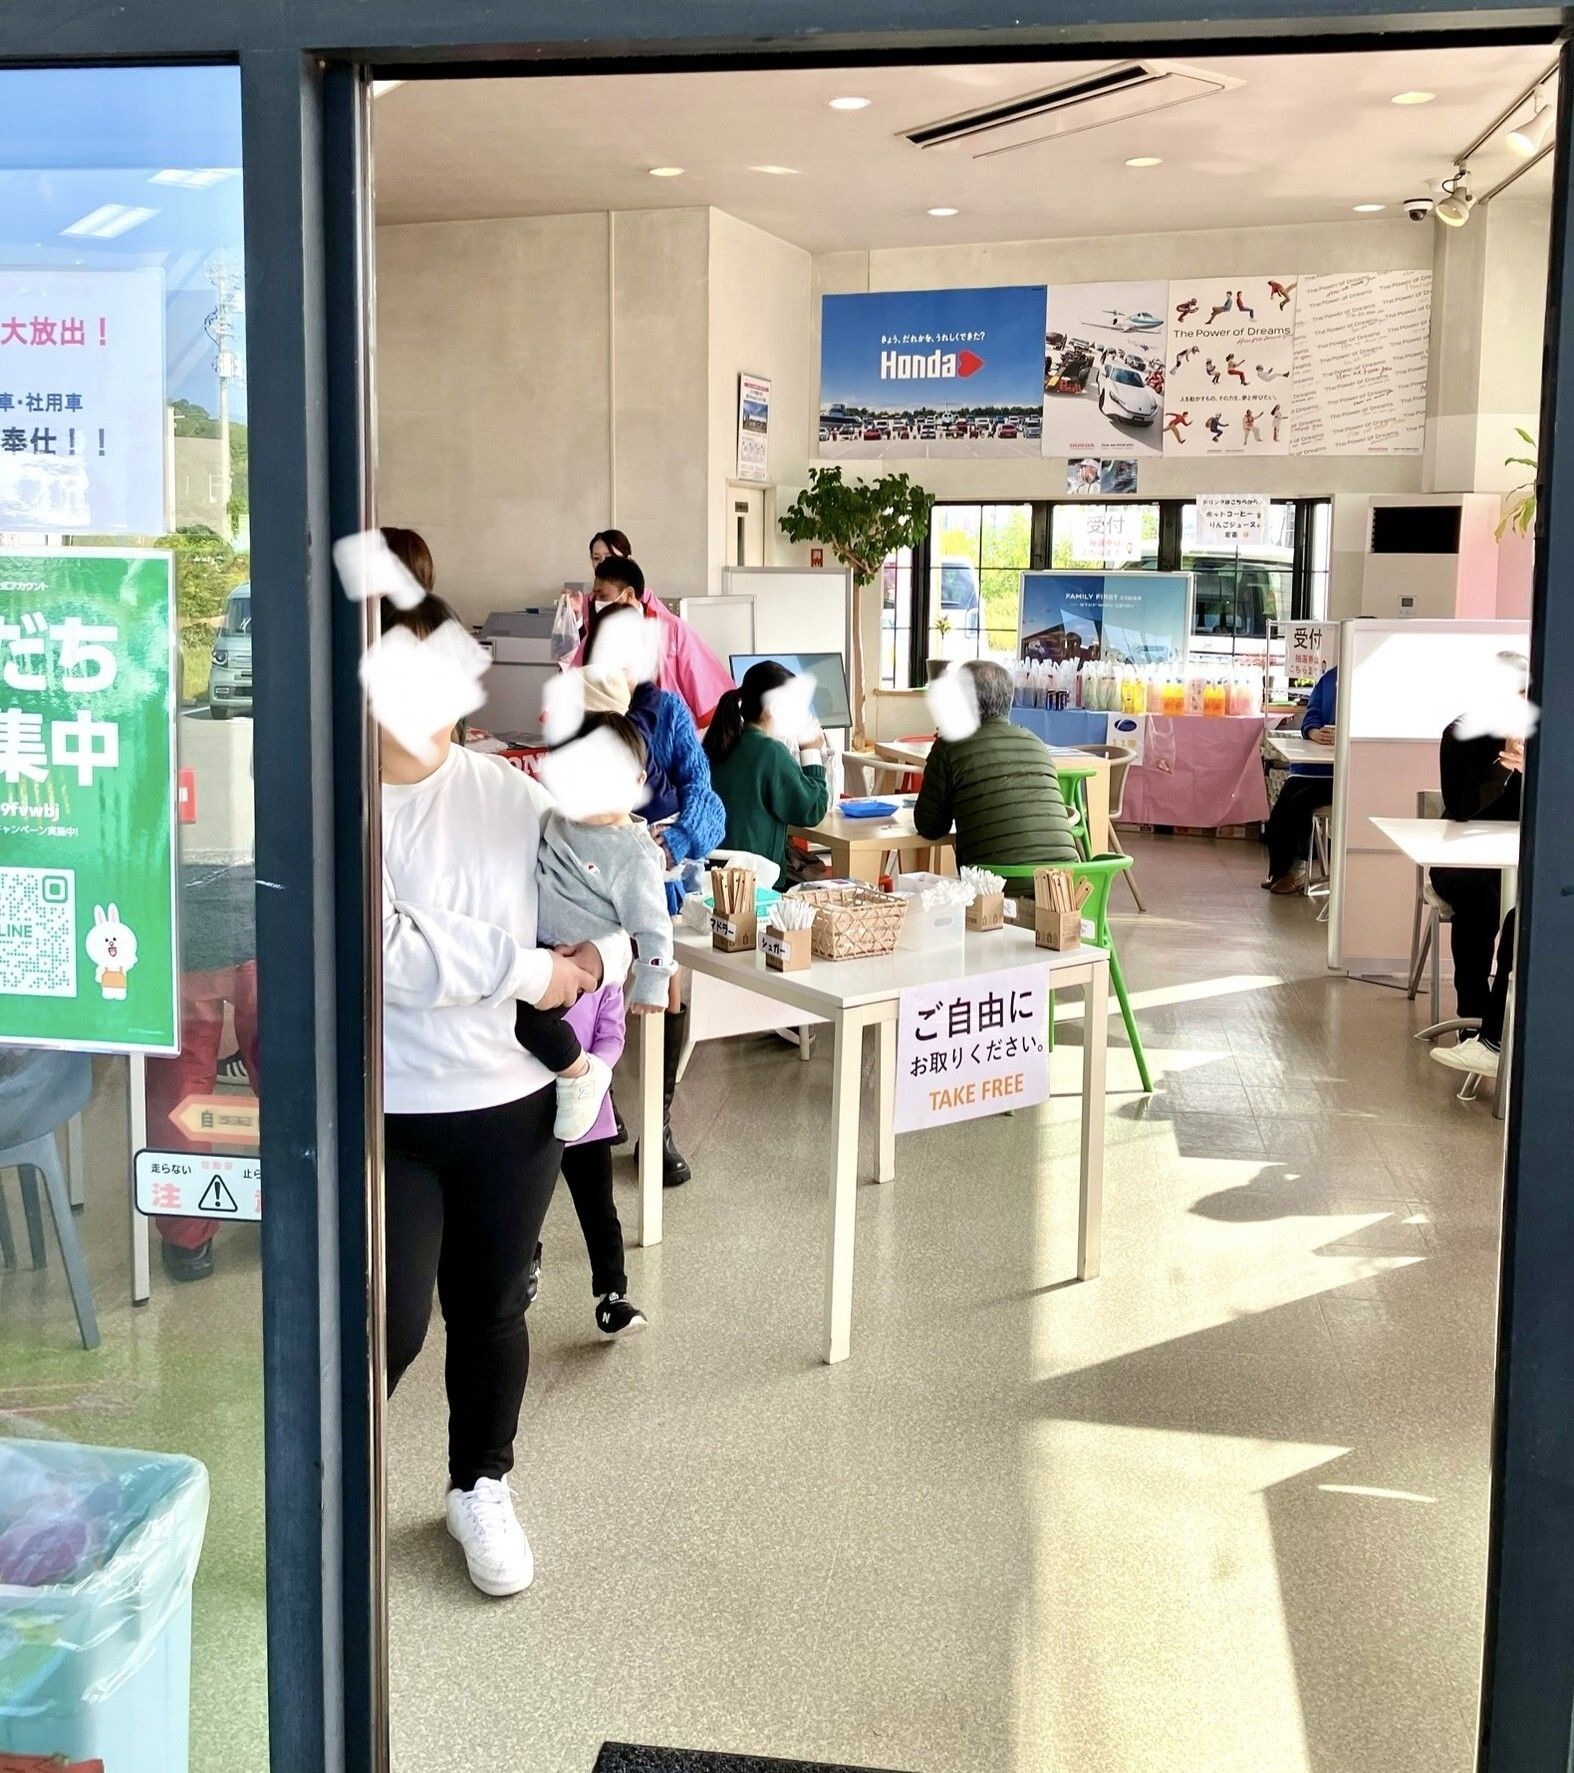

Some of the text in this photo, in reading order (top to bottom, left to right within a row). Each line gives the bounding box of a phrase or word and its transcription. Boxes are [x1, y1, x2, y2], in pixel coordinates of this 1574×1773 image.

[2, 316, 107, 346] 大放出！
[1174, 326, 1291, 338] The Power of Dreams
[880, 349, 957, 380] Honda
[2, 427, 105, 456] 奉仕！！
[1086, 515, 1125, 534] 受付
[1096, 593, 1118, 601] FIRST
[0, 610, 119, 693] だち
[1293, 627, 1322, 650] 受付
[0, 707, 119, 787] 集中
[710, 918, 735, 936] マドラー
[761, 936, 786, 955] シュガー
[915, 990, 1034, 1042] ご自由に
[910, 1036, 1043, 1077] お取りください。
[928, 1073, 1024, 1112] TAKE FREE
[150, 1162, 192, 1174] 走らない
